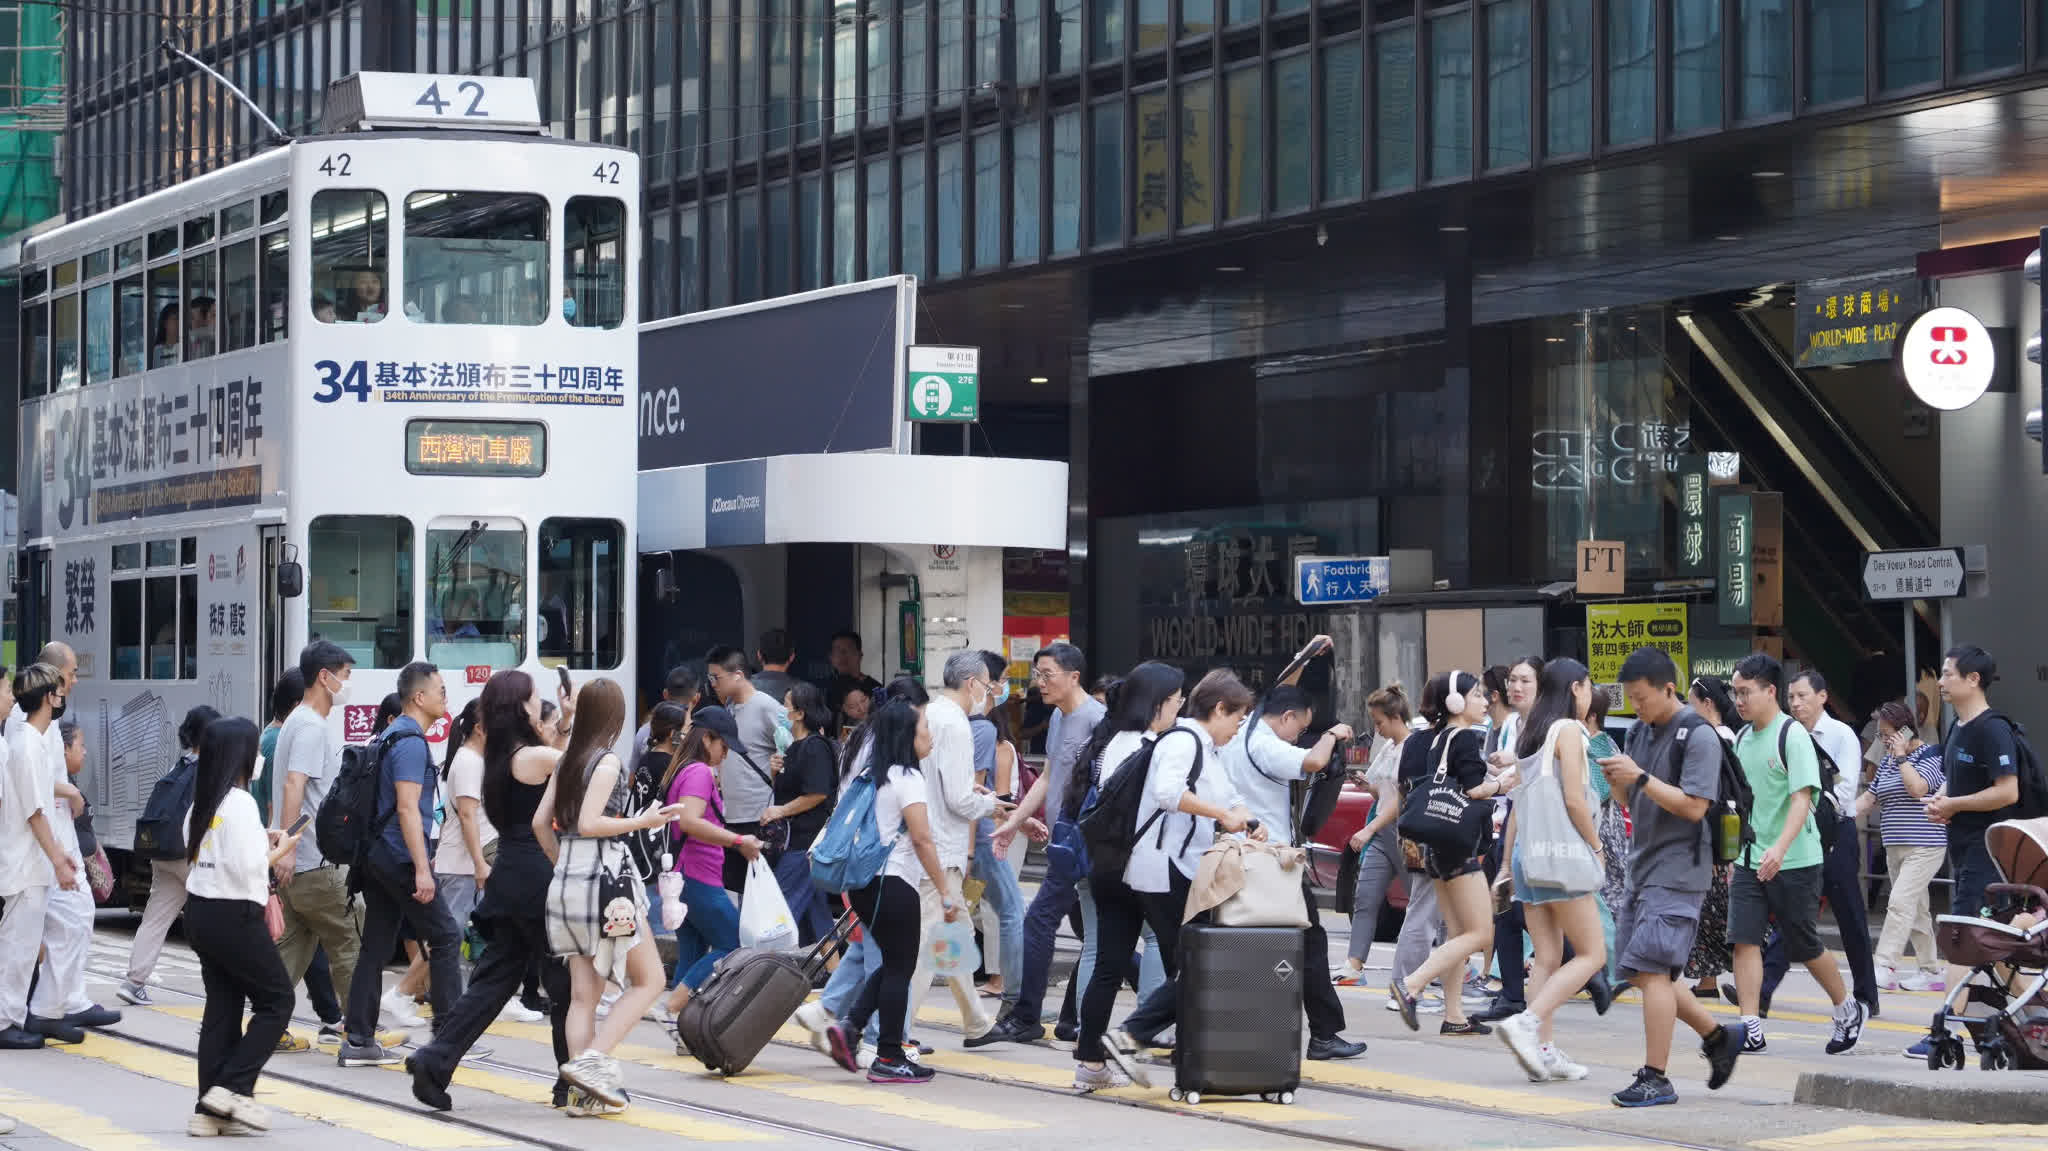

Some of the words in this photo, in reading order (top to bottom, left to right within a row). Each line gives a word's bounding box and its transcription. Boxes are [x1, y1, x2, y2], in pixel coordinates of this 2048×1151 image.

[416, 80, 489, 116] 42
[319, 153, 352, 177] 42
[593, 161, 620, 184] 42
[1825, 289, 1890, 320] 環球商場
[1810, 325, 1868, 349] WORLD-WIDE
[1874, 321, 1900, 342] PLAZ
[312, 359, 372, 403] 34
[375, 361, 625, 391] 基本法頒布三十四周年
[958, 376, 974, 385] 27E
[385, 391, 408, 401] 34th
[409, 391, 466, 402] Anniversary
[468, 391, 479, 401] of
[480, 391, 496, 401] the
[569, 394, 583, 403] the
[584, 394, 606, 404] Basic
[606, 395, 623, 405] Law
[640, 386, 685, 437] nce.
[93, 376, 262, 481] 基本法頒布三十四周年
[59, 408, 91, 530] 34
[1584, 547, 1621, 573] FT
[1873, 560, 1886, 571] Des
[1887, 558, 1907, 571] Voeux
[1908, 558, 1926, 570] Road
[1927, 555, 1953, 569] Central
[64, 555, 96, 637] 繁榮
[1151, 615, 1273, 657] WORLD-WIDE
[1591, 620, 1644, 639] 沈大師
[468, 667, 488, 681] 120
